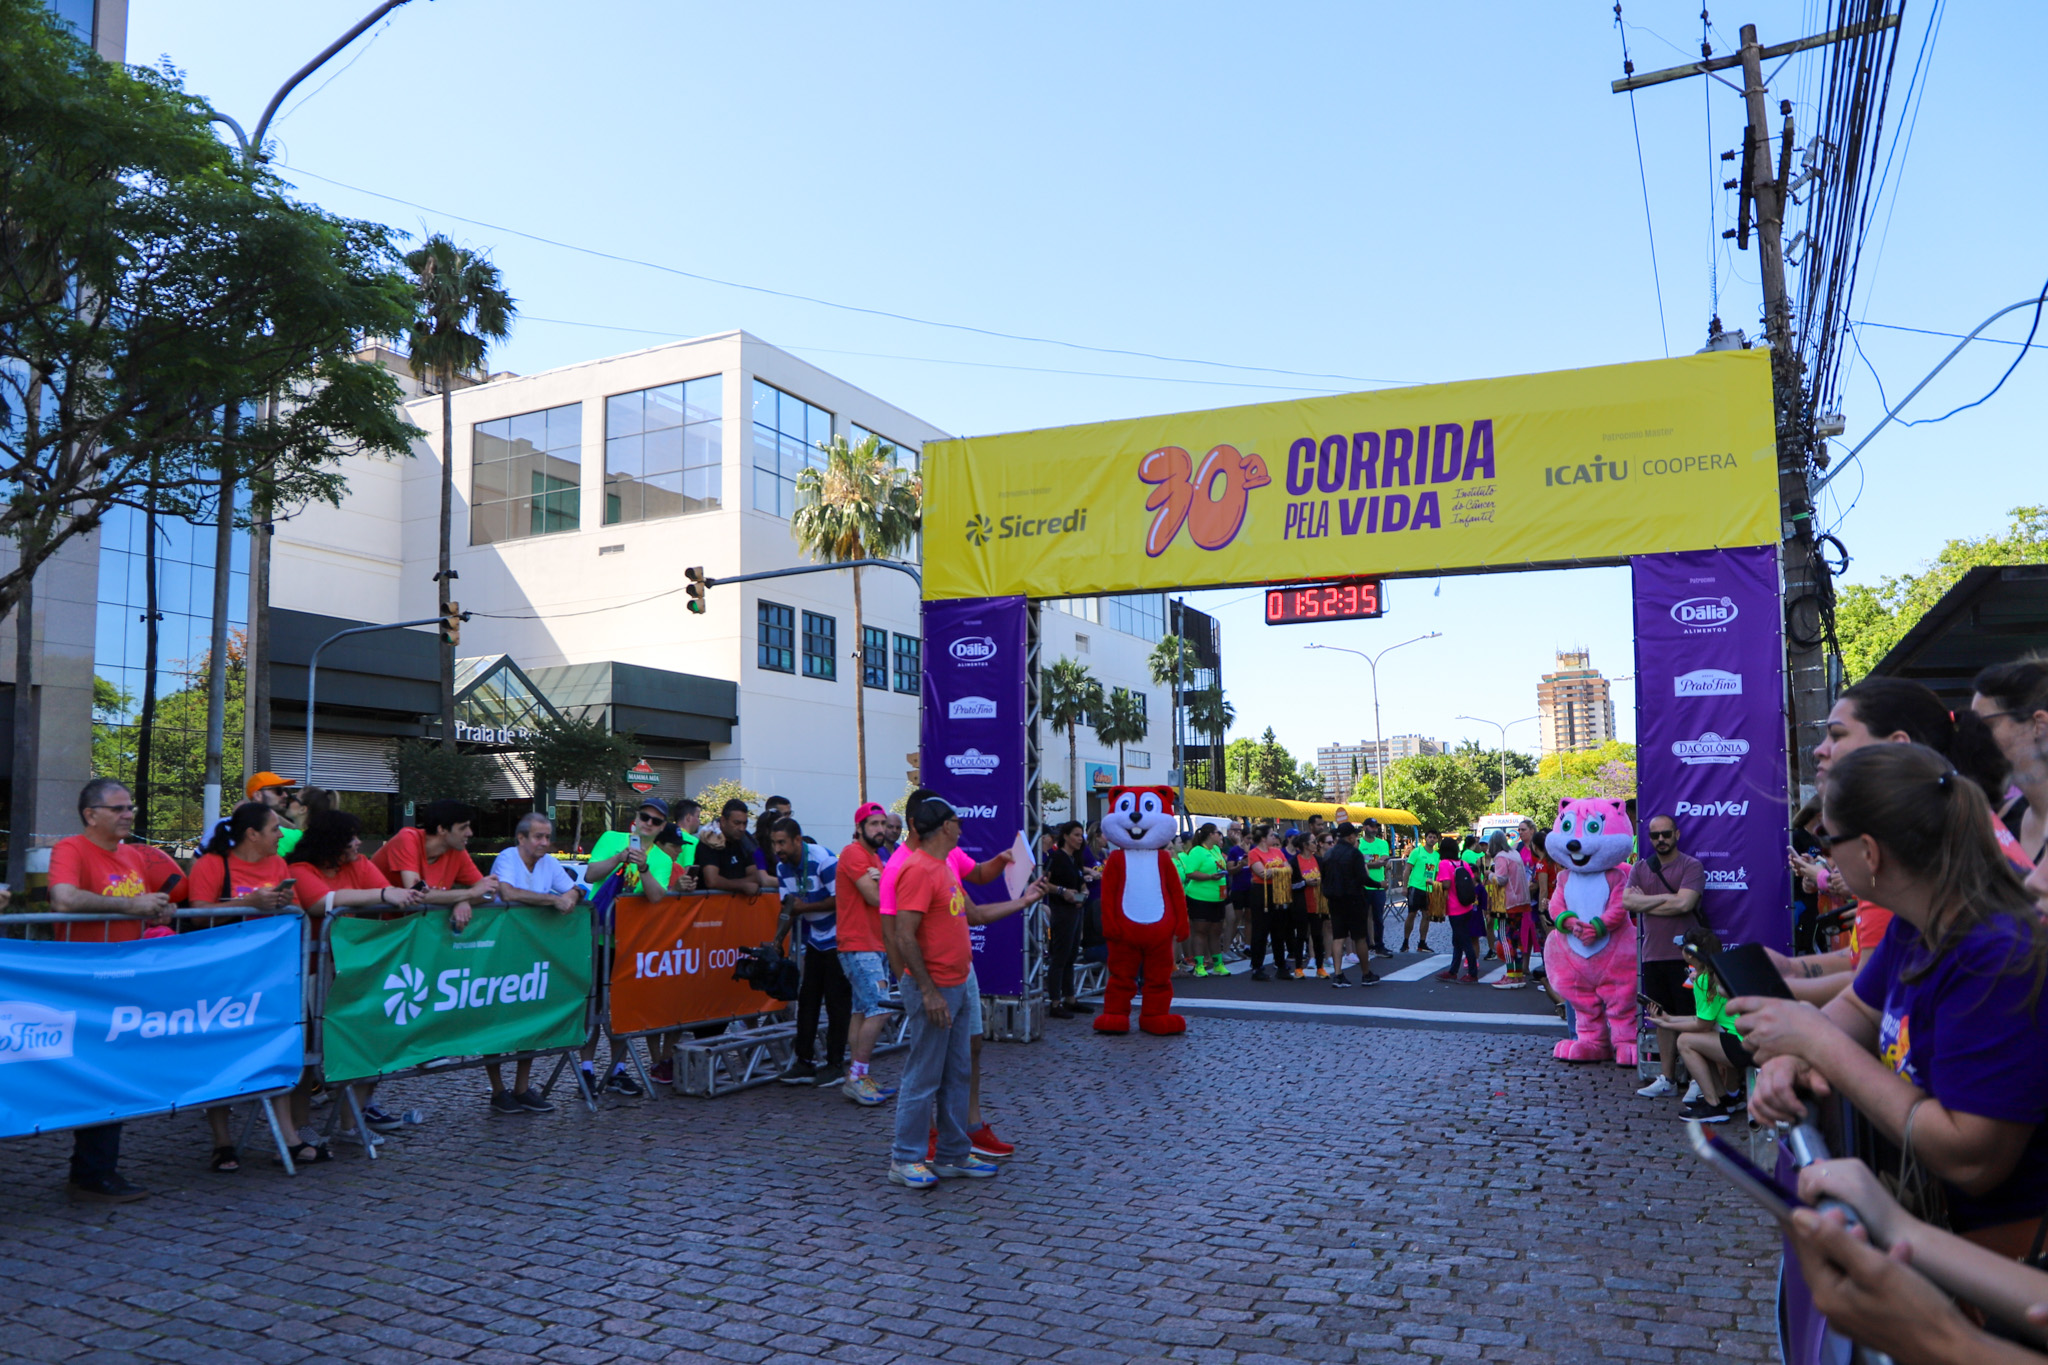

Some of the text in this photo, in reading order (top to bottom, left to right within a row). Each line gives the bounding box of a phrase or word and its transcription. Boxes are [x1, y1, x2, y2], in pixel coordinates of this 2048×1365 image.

[1285, 419, 1496, 496] CORRIDA
[1545, 452, 1738, 487] ICATU COOPERA
[1451, 484, 1497, 499] Instituto
[1465, 499, 1496, 510] Câncer
[998, 508, 1087, 539] Sicredi
[1283, 491, 1442, 540] PELA VIDA
[1450, 509, 1495, 527] Infantil
[1681, 604, 1728, 621] Dália
[956, 643, 990, 657] Dália
[454, 719, 495, 743] Praia
[497, 724, 516, 745] de
[1674, 801, 1749, 817] PanVel
[635, 939, 700, 979] ICATU
[433, 961, 550, 1012] Sicredi
[104, 992, 262, 1042] PanVel
